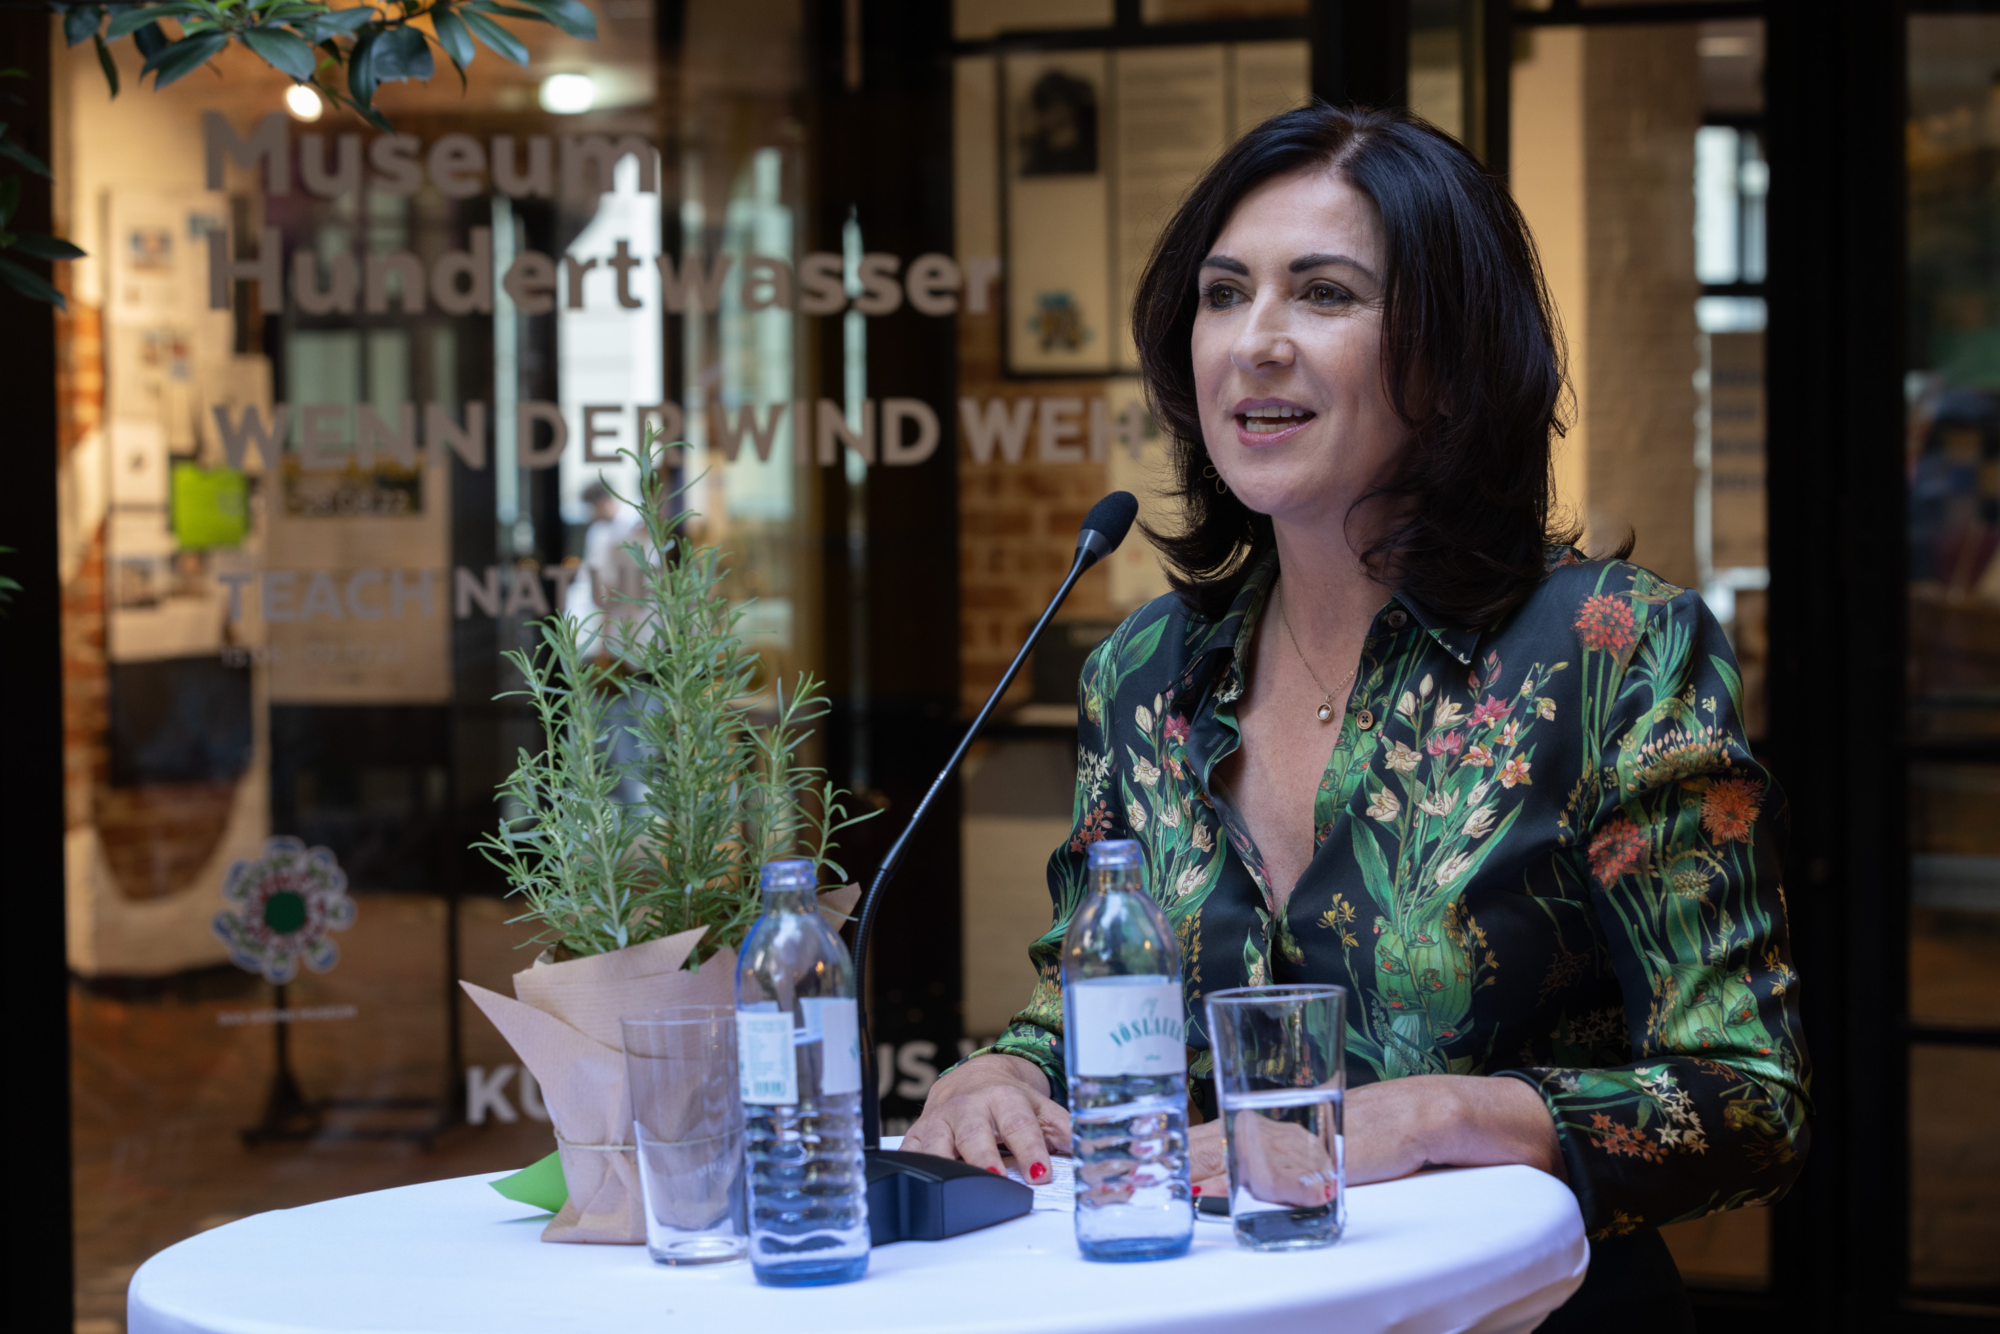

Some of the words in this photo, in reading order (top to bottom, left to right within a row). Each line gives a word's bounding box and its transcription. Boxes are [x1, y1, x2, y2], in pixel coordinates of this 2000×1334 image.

[203, 110, 658, 197] Museum
[207, 227, 1001, 316] Hundertwasser
[212, 401, 488, 471] WENN
[517, 400, 684, 470] DER
[709, 397, 941, 467] WIND
[958, 395, 1144, 466] WEH
[219, 568, 435, 622] TEACH
